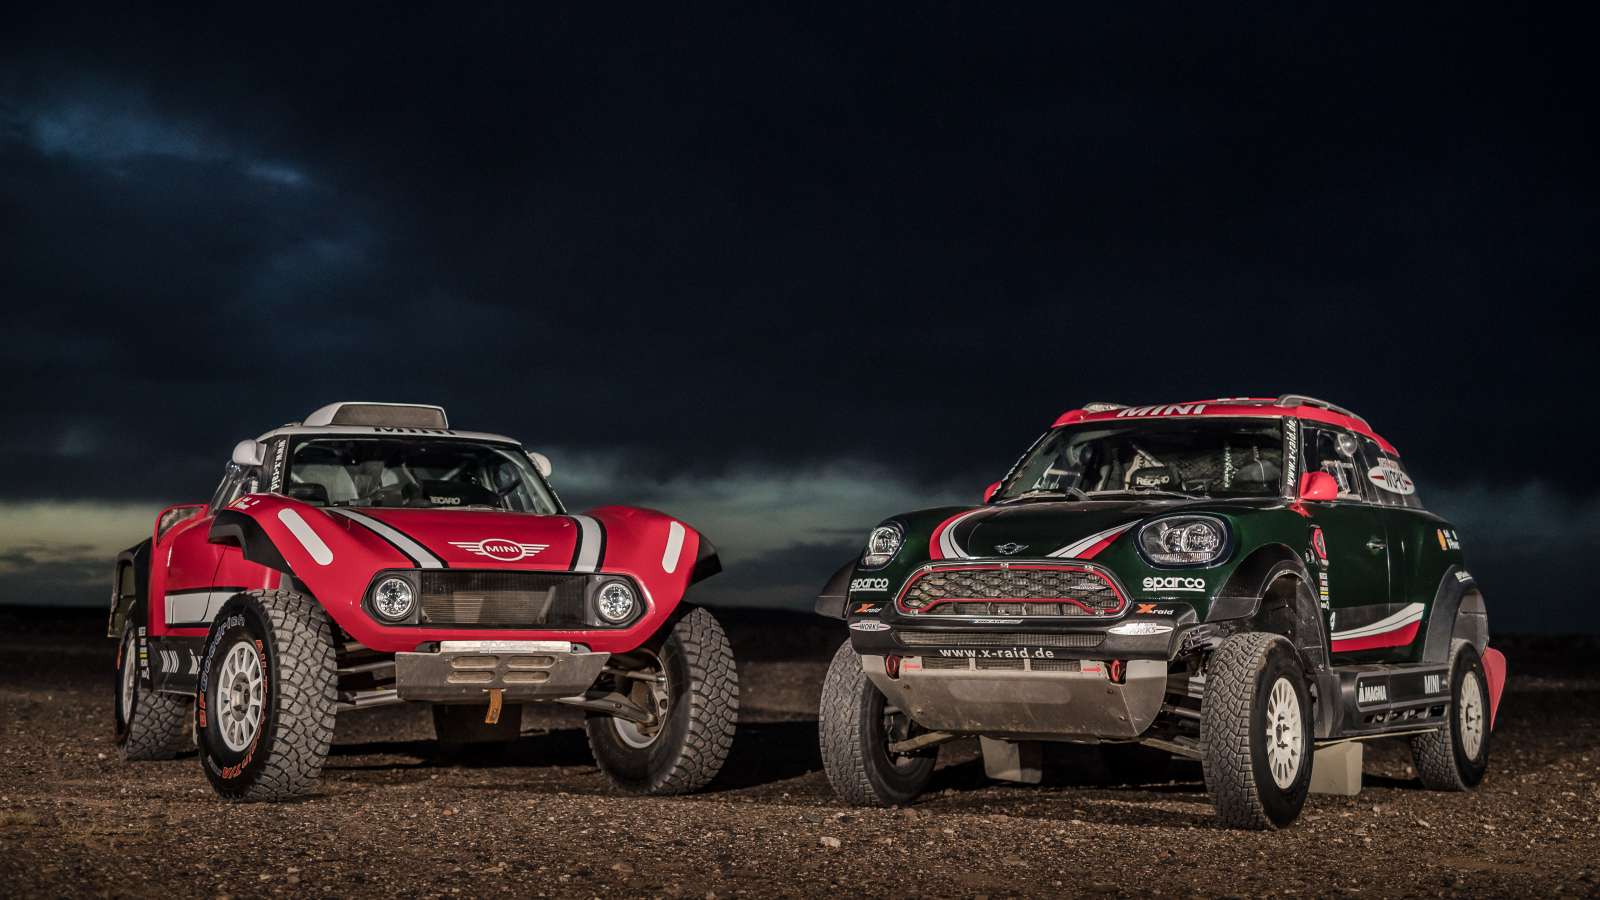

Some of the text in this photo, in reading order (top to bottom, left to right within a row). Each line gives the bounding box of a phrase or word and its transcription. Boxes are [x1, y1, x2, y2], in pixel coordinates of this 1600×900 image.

[1116, 404, 1206, 418] MINI
[485, 545, 520, 554] MINI
[851, 577, 889, 592] sparco
[1142, 575, 1206, 592] sparco
[938, 647, 1056, 659] www.x-raid.de
[1423, 674, 1440, 696] MINI
